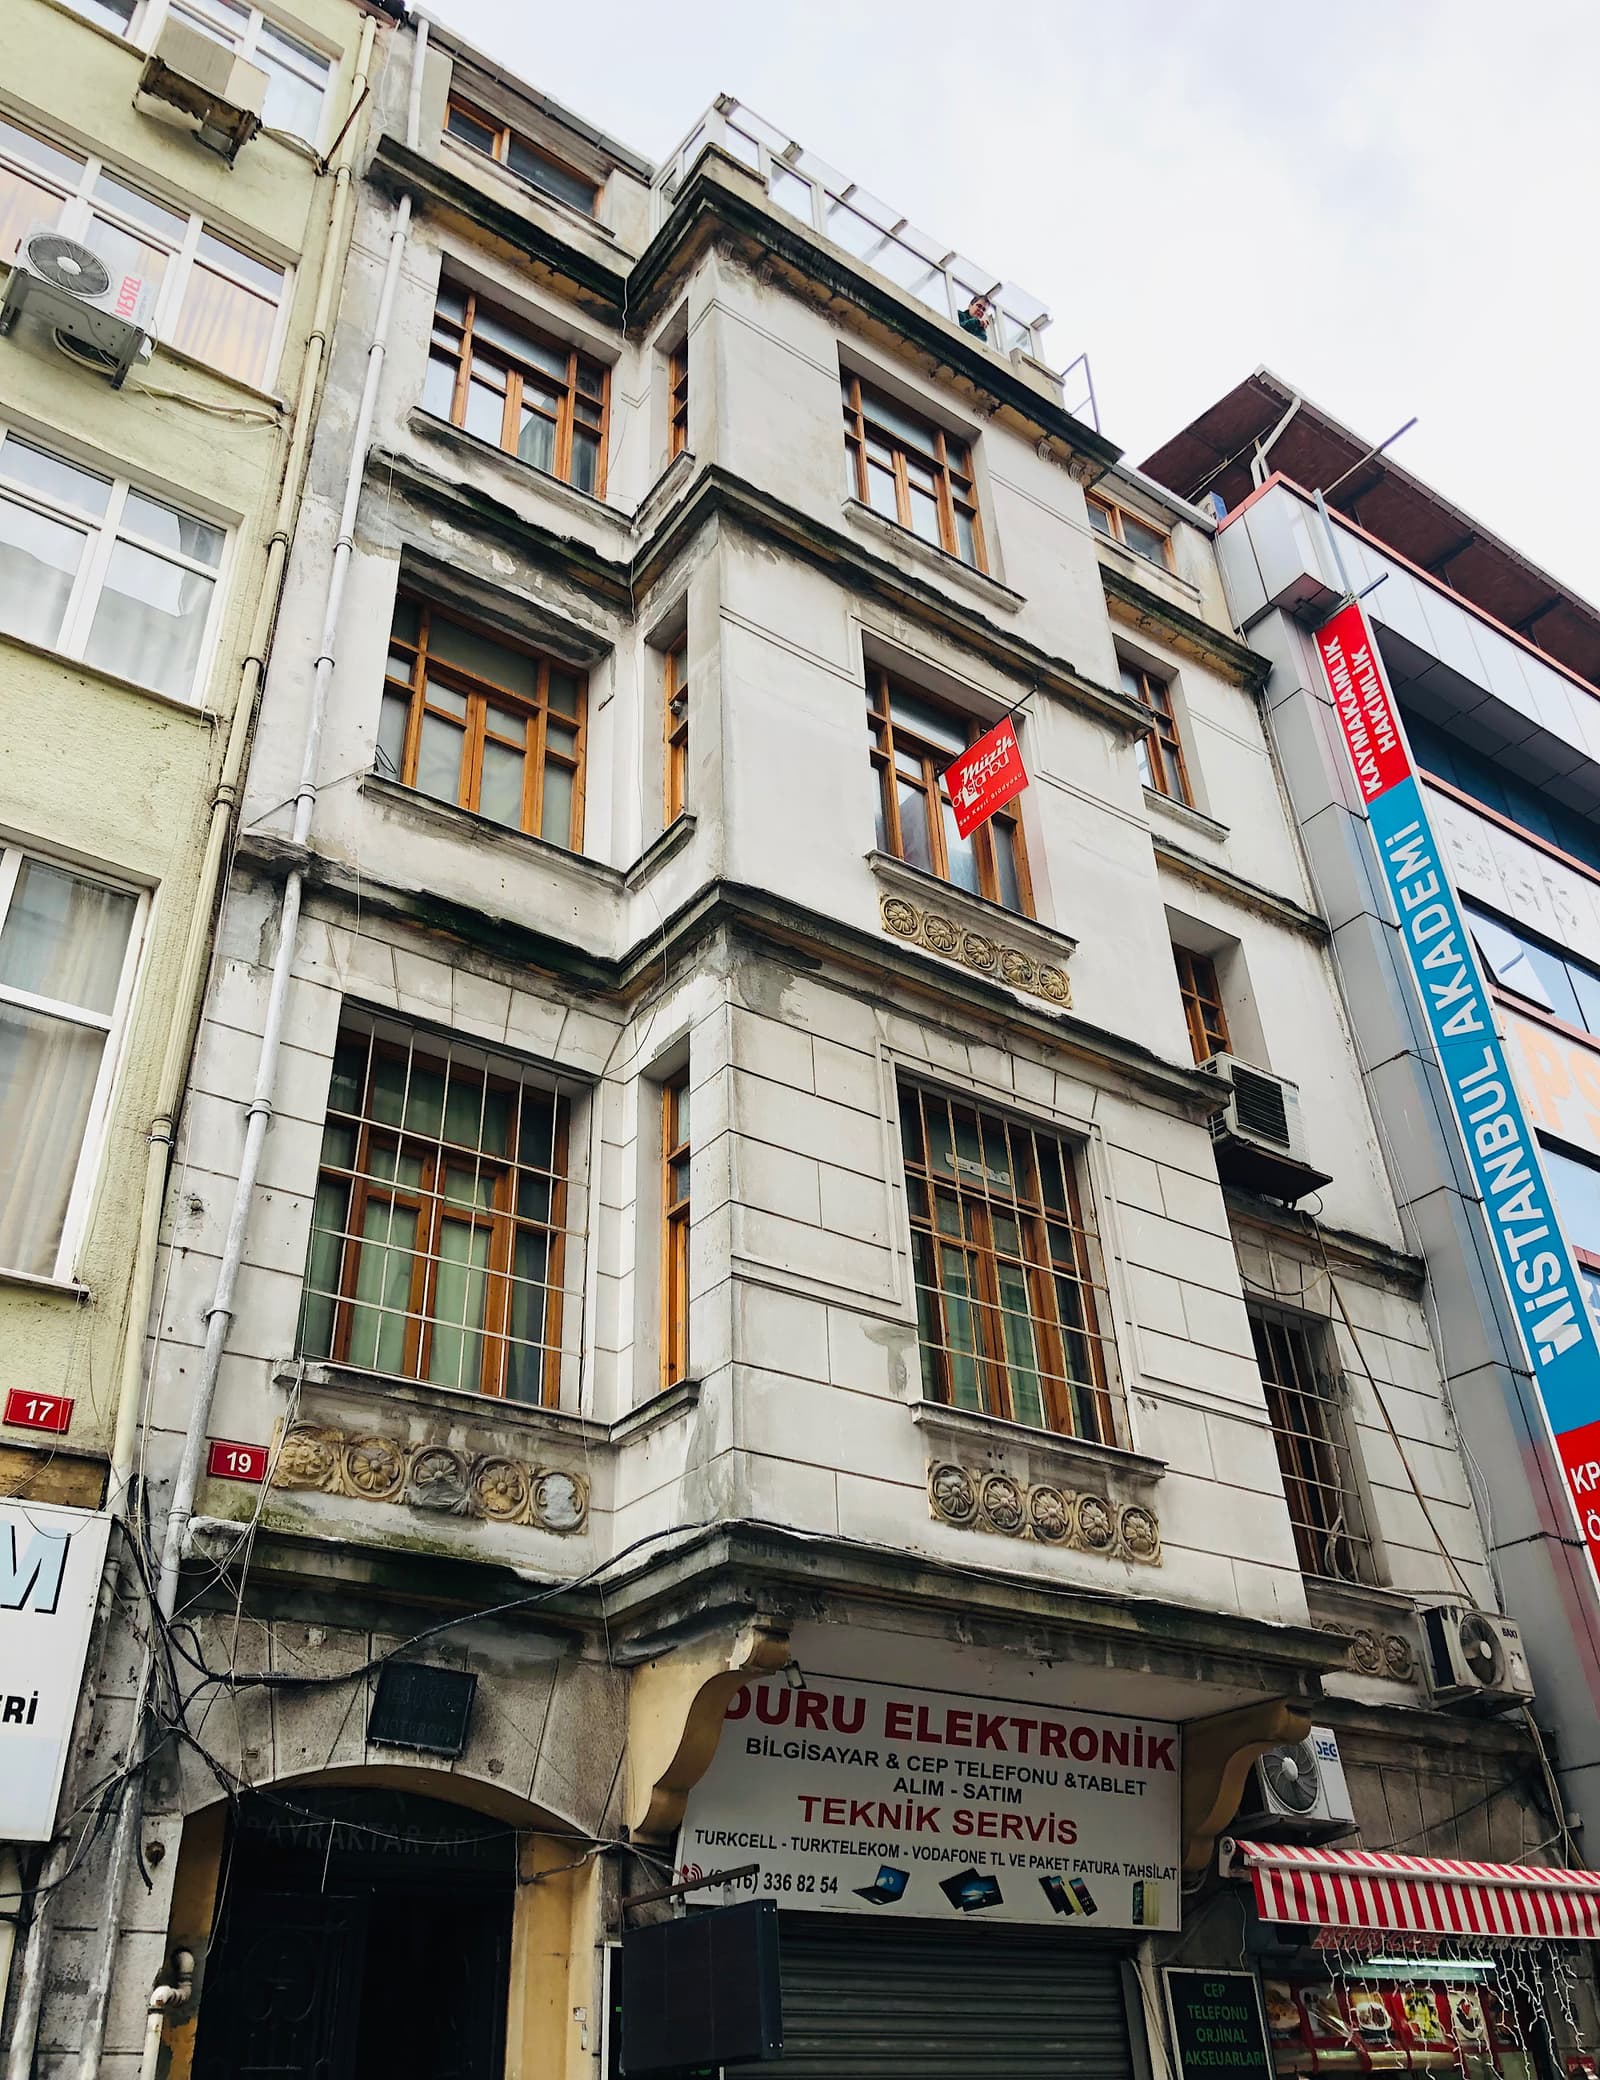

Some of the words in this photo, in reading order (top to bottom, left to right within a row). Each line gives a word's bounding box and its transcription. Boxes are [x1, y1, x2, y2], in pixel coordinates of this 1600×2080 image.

[1323, 635, 1383, 796] KAYMAKAMLIK
[1351, 643, 1397, 754] HAKİMLİK
[1385, 820, 1485, 1037] AKADEMİ
[25, 1399, 54, 1422] 17
[226, 1451, 251, 1473] 19
[0, 1690, 39, 1725] Rİ
[884, 1701, 1177, 1772] ELEKTRONİK
[745, 1736, 879, 1768] BİLGİSAYAR
[886, 1753, 900, 1770] &
[907, 1755, 949, 1774] CEP
[955, 1759, 1058, 1786] TELEFONU
[893, 1777, 944, 1797] ALIM
[963, 1782, 1023, 1804] SATIM
[797, 1795, 941, 1833] TEKNİK
[952, 1808, 1078, 1845] SERVİS
[695, 1829, 778, 1849] TURKCELL
[790, 1836, 900, 1858] TURKTELEKOM
[912, 1846, 986, 1865] VODAFONE
[990, 1851, 1005, 1866] TL
[1009, 1853, 1026, 1868] VE
[1029, 1855, 1070, 1871] PAKET
[1073, 1859, 1120, 1876] FATURA
[1123, 1862, 1177, 1881] TAHSİLAT
[763, 1872, 792, 1891] 336
[797, 1874, 815, 1892] 82
[820, 1876, 838, 1894] 54
[1203, 1983, 1226, 1998] CEP
[1187, 2004, 1248, 2021] TELEFONU
